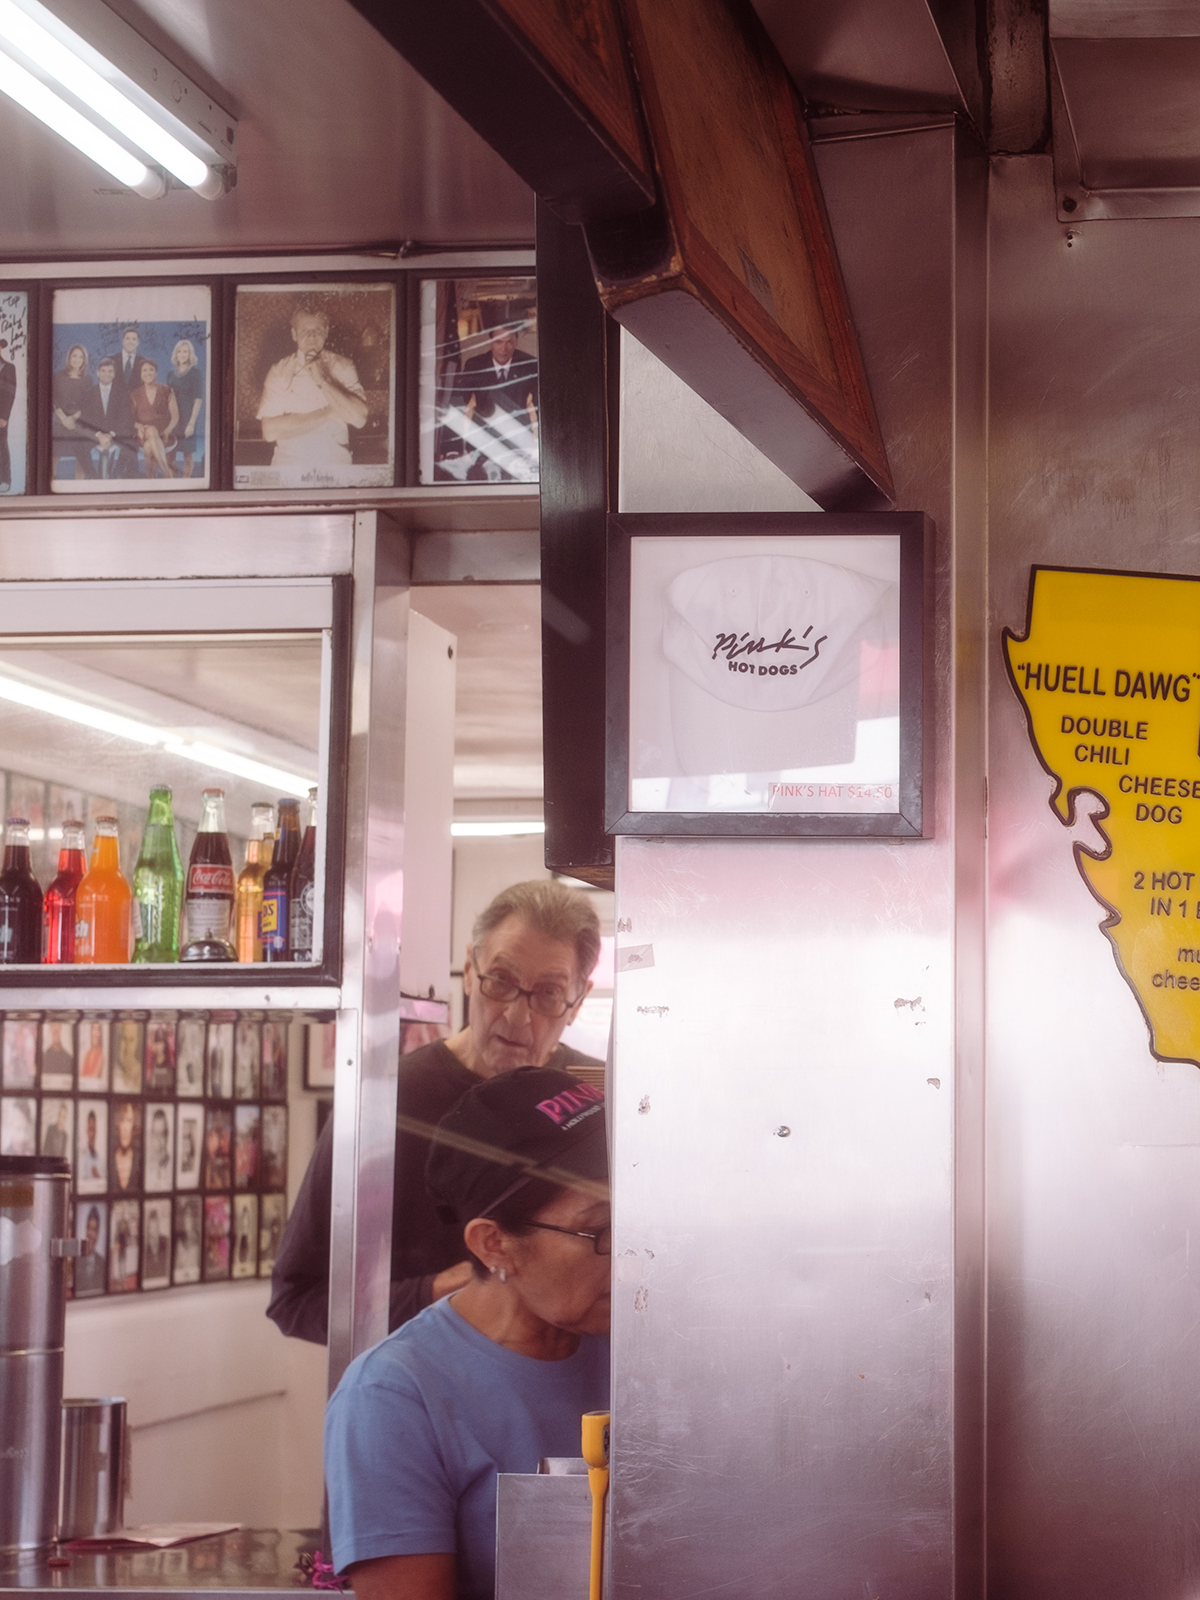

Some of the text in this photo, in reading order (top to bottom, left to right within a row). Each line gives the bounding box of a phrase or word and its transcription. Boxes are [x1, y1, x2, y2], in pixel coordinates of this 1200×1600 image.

[712, 625, 828, 670] Pink's
[728, 660, 798, 676] HOT DOGS
[1060, 715, 1149, 741] DOUBLE
[1074, 744, 1131, 766] CHILI
[772, 784, 893, 799] PINK'S HAT $14.50
[1135, 802, 1184, 826] DOG
[1133, 871, 1145, 891] 2
[1151, 871, 1196, 893] HOT
[1150, 897, 1172, 917] IN
[1178, 900, 1188, 919] 1
